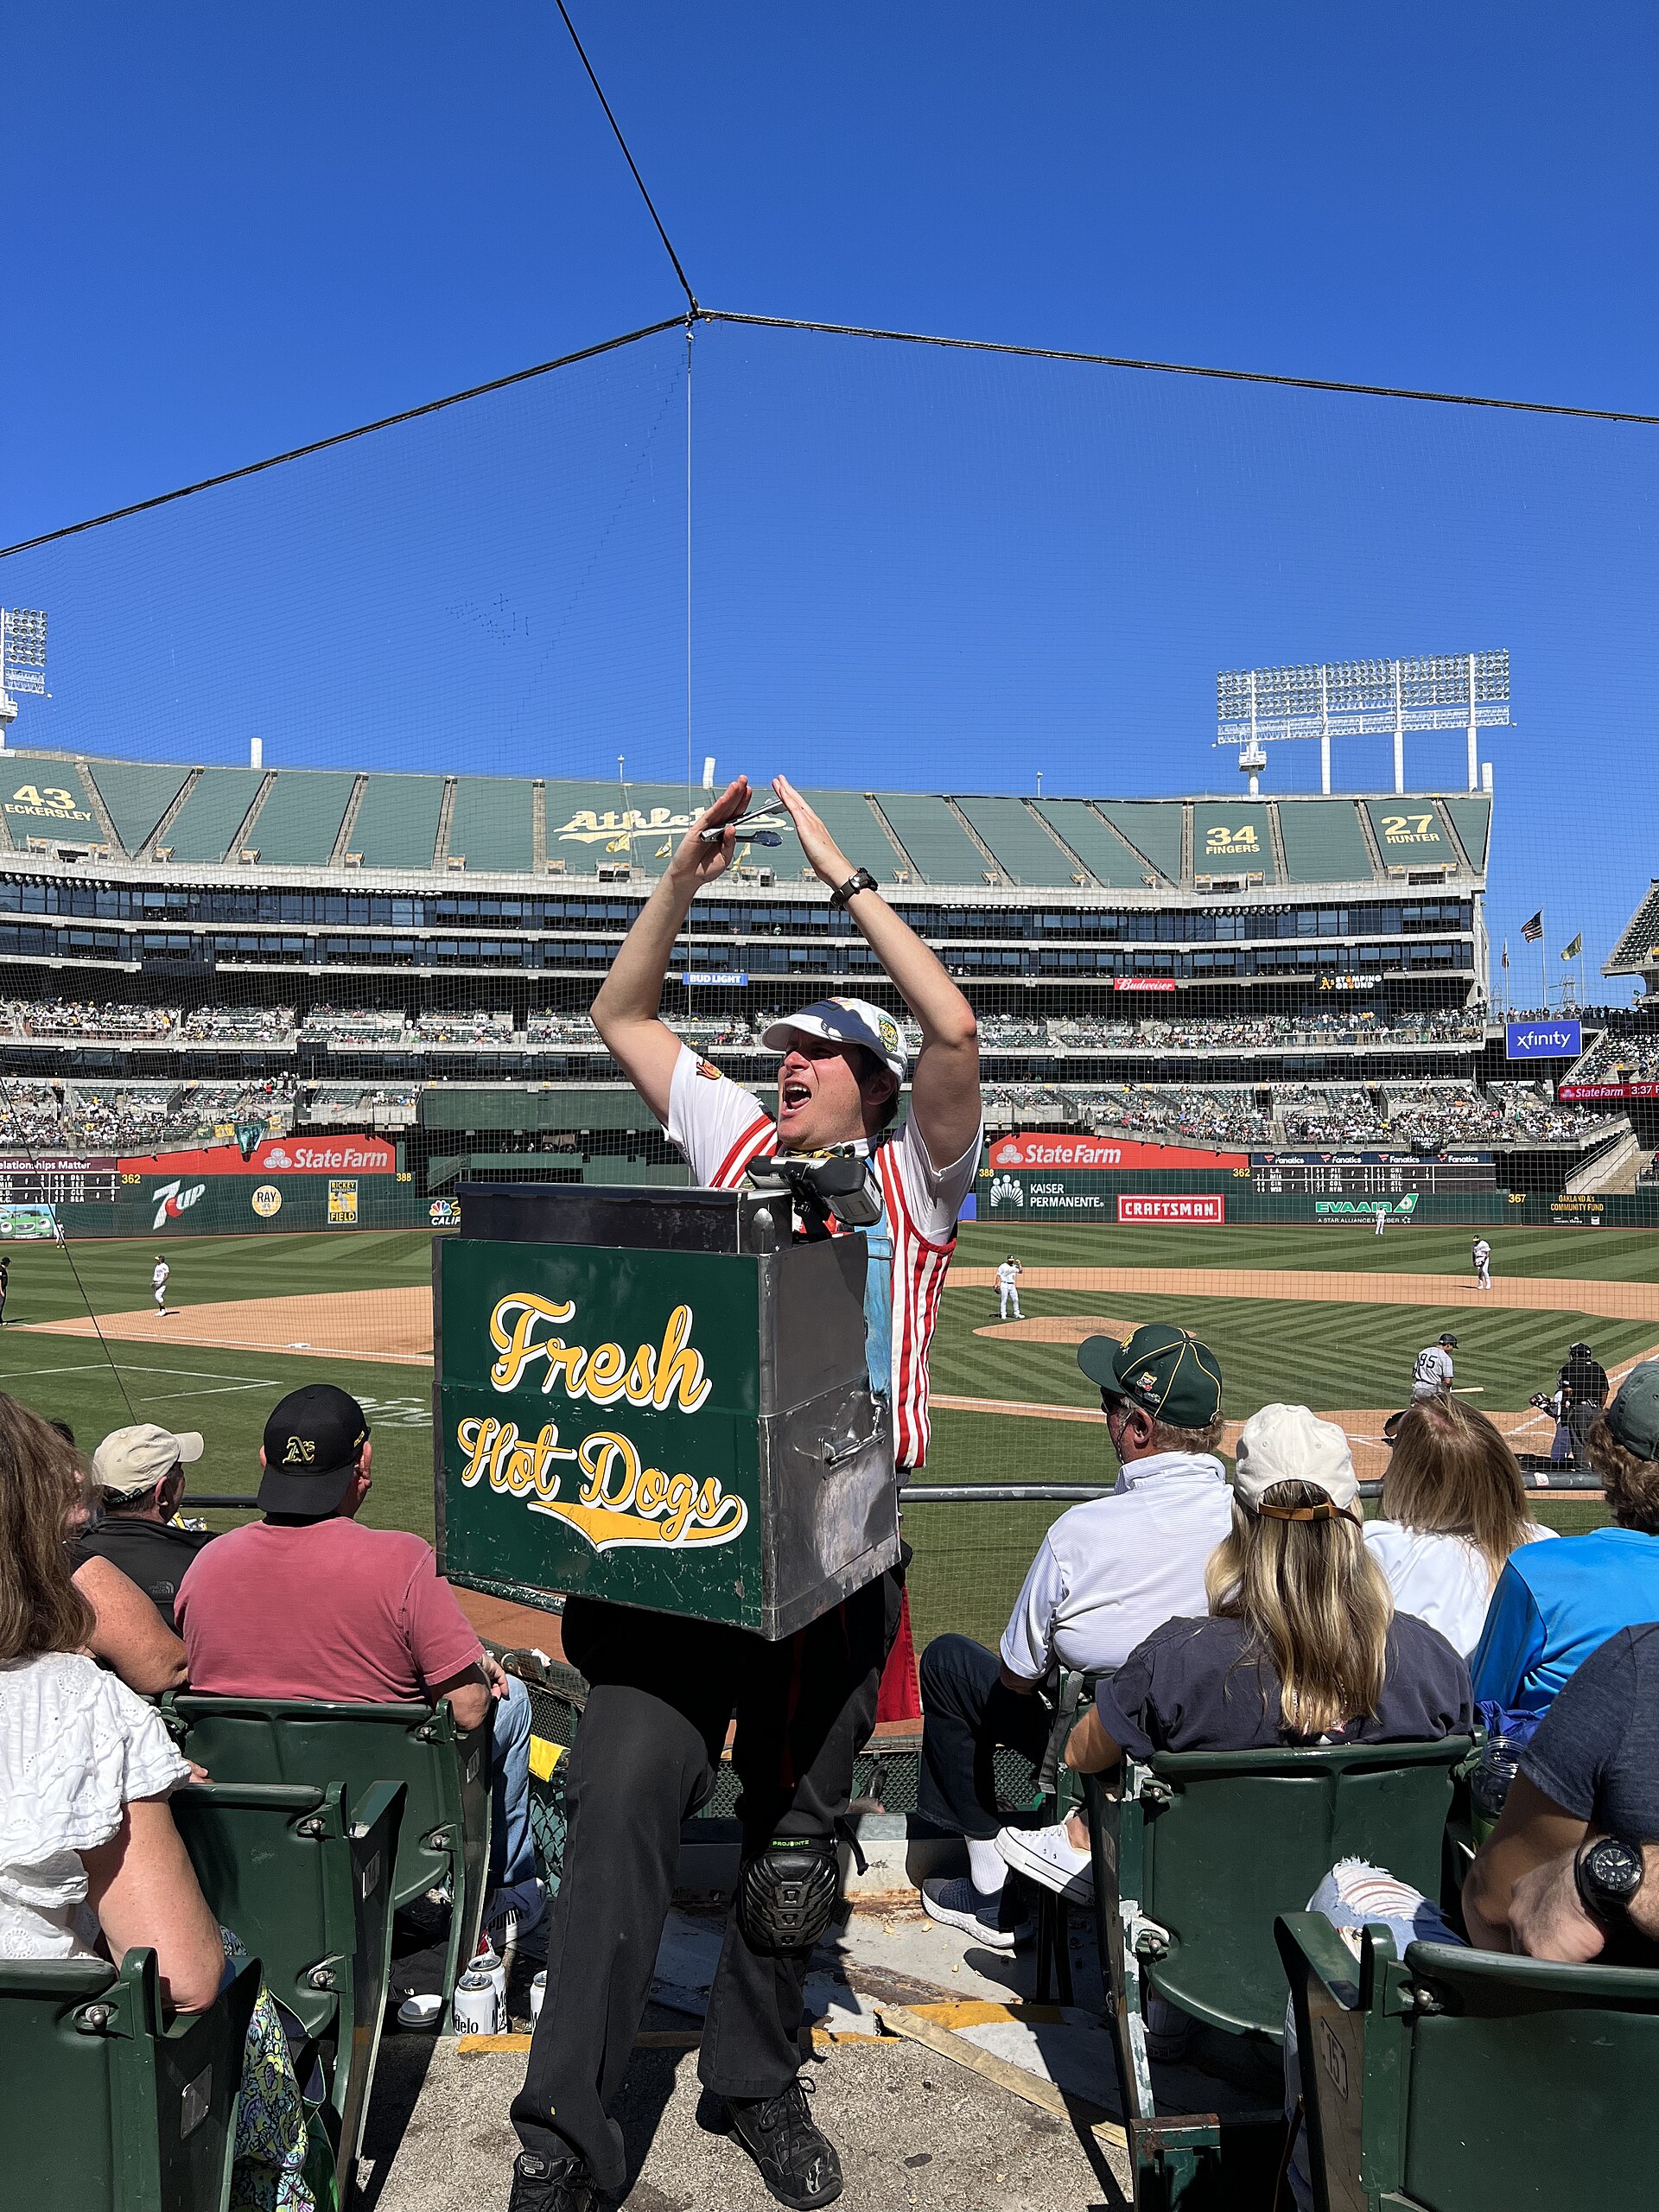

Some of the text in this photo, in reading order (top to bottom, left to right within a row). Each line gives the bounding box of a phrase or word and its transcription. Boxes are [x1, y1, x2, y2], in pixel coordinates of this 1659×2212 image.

[12, 785, 77, 810] 43
[4, 804, 92, 822] ECKERSLEY
[1381, 814, 1433, 836] 27
[1206, 825, 1258, 846] 34
[1386, 833, 1440, 844] HUNTER
[1205, 844, 1261, 855] FINGERS
[690, 974, 741, 983] BUD LIGHT
[1116, 978, 1173, 990] Budweiser
[1516, 1030, 1572, 1050] xfinity
[1630, 1085, 1652, 1095] 3:37
[0, 1160, 92, 1171] elationhips Matter
[396, 1173, 412, 1182] 388
[978, 1168, 995, 1178] 388
[1232, 1168, 1251, 1178] 362
[121, 1174, 141, 1185] 362
[1030, 1183, 1065, 1194] KAISER
[257, 1192, 276, 1203] RAY
[1030, 1196, 1101, 1207] PERMANENTE
[1508, 1193, 1527, 1204] 367
[1558, 1194, 1586, 1203] OAKLAND
[1550, 1203, 1604, 1211] COMMUNITY FUND
[331, 1212, 355, 1222] FIELD
[431, 1216, 461, 1226] CALIF
[489, 1291, 715, 1414] Fresh
[457, 1416, 749, 1544] Hot Dogs
[455, 2013, 479, 2034] delo
